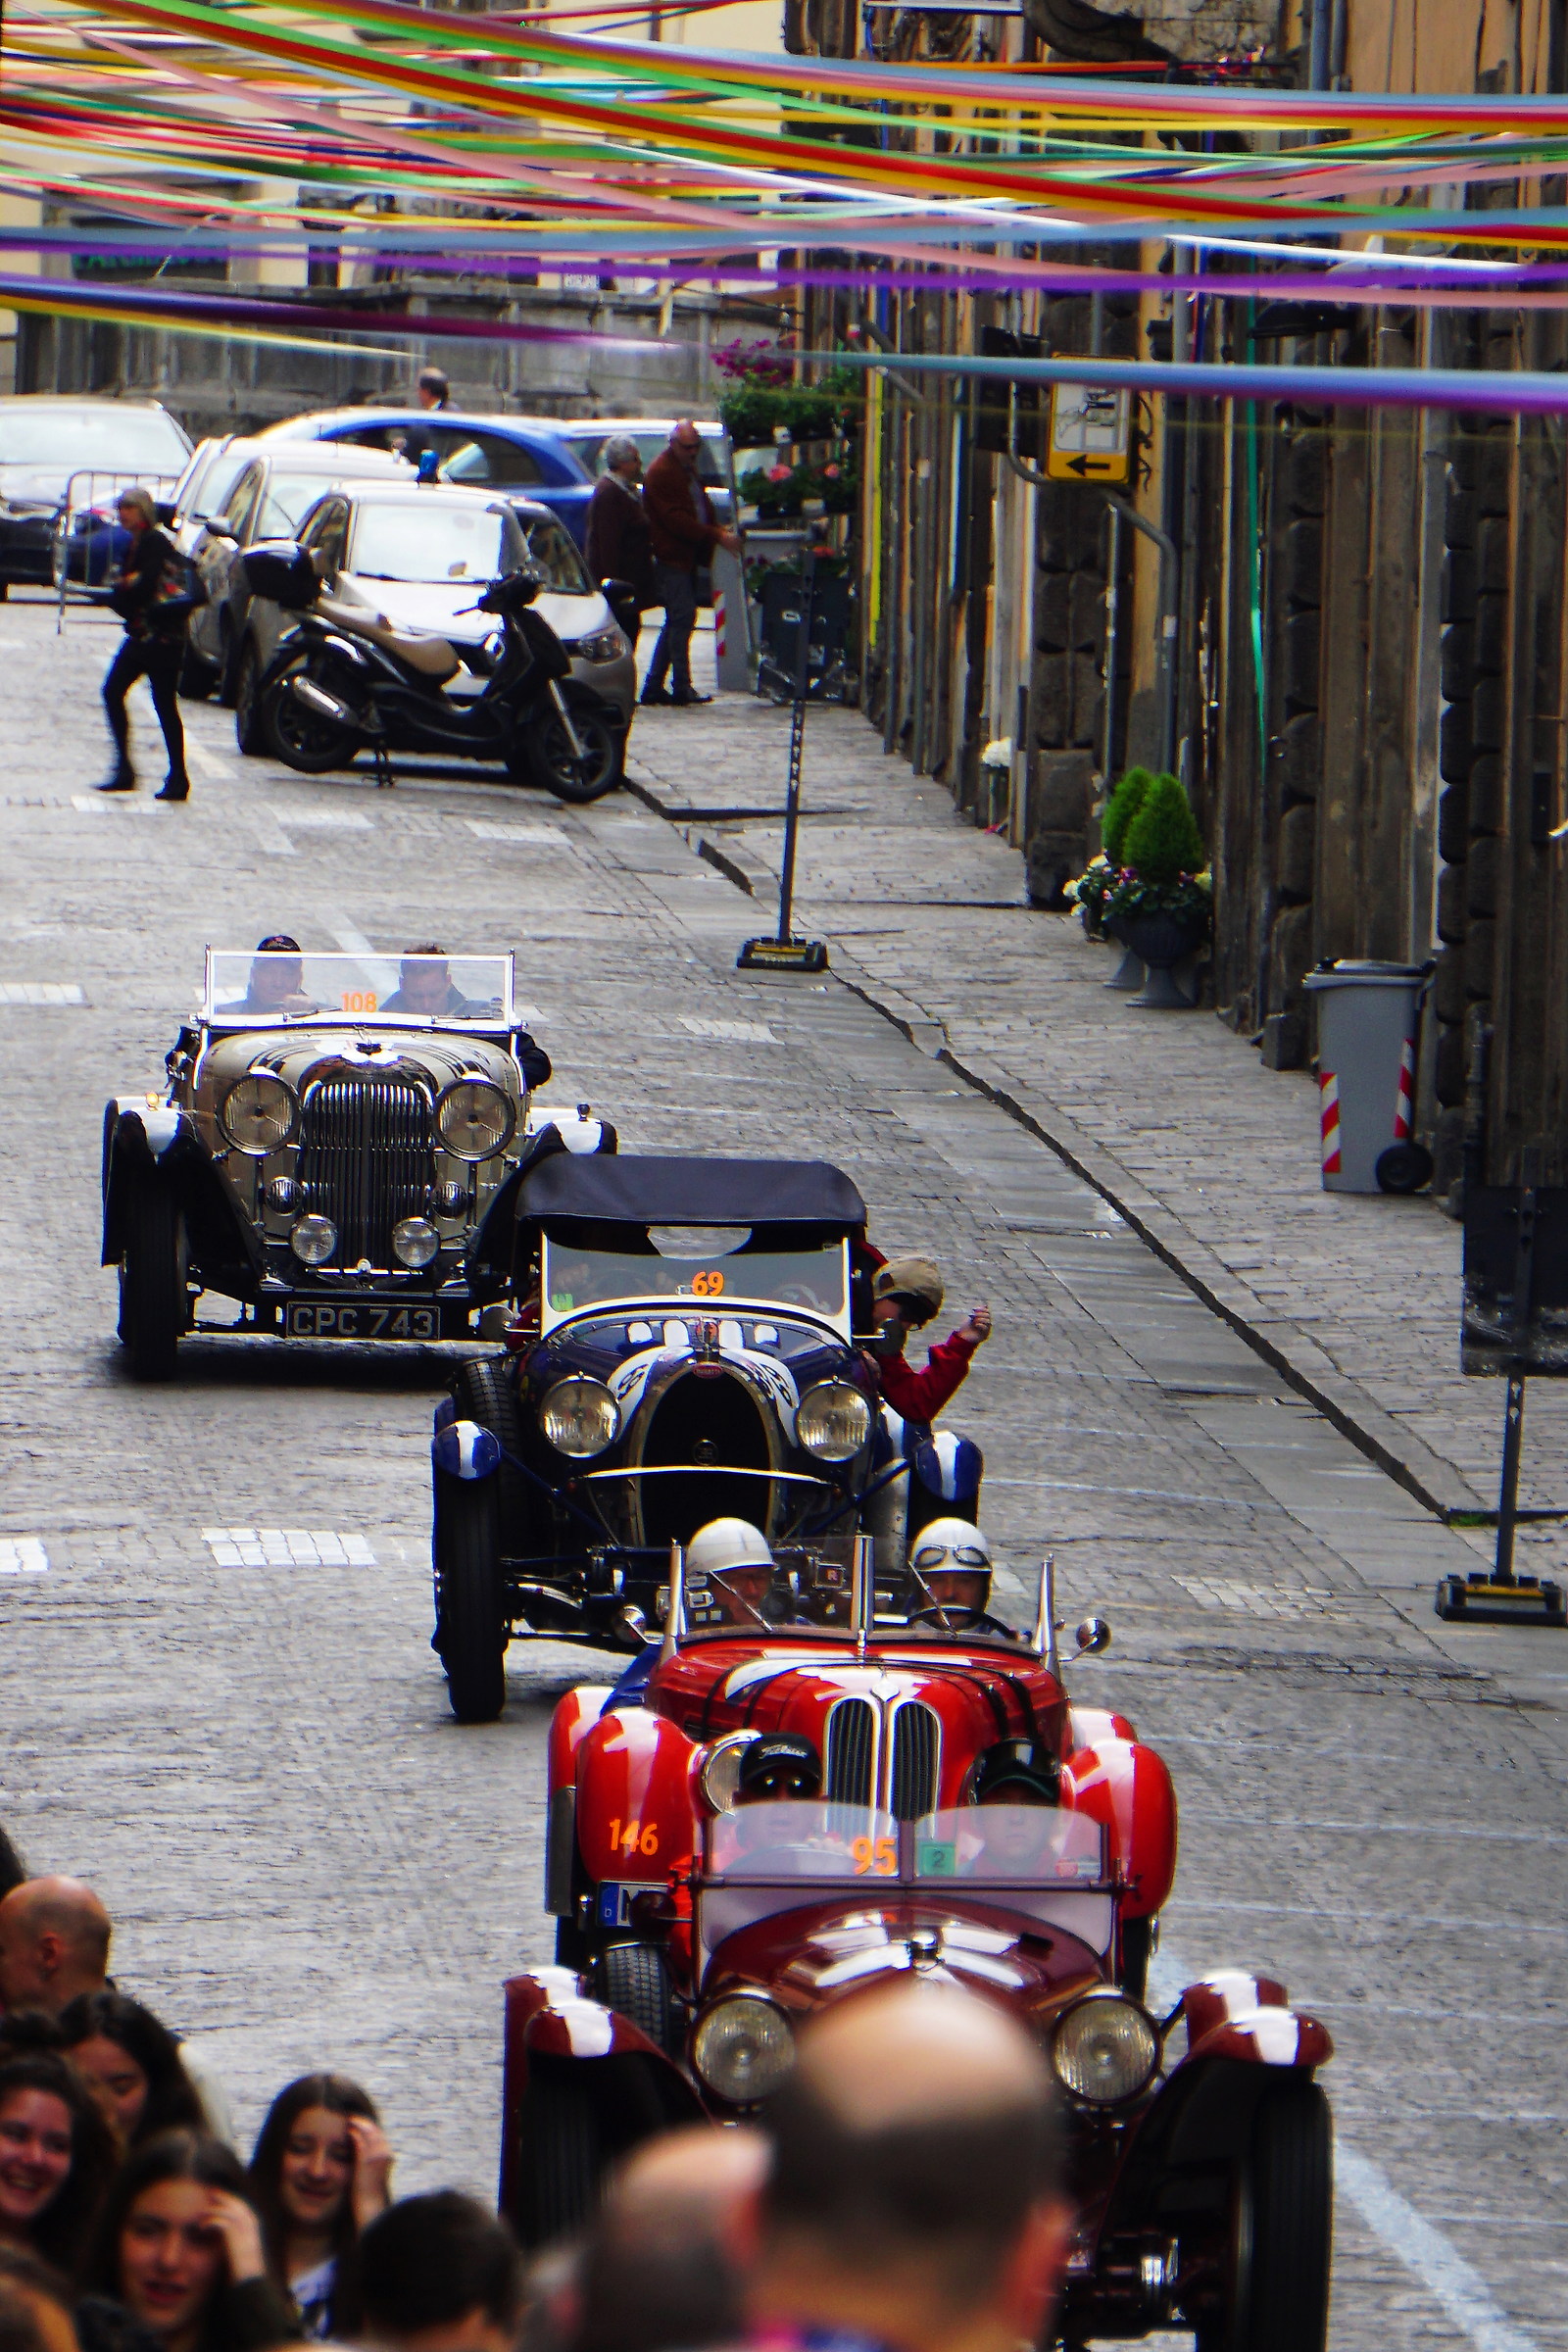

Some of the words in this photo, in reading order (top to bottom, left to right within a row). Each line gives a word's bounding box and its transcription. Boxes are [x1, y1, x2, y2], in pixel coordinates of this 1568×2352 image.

[341, 991, 377, 1012] 108
[692, 1271, 723, 1296] 69
[293, 1307, 358, 1336] CPC
[369, 1309, 433, 1338] 743
[610, 1819, 659, 1855] 146
[852, 1837, 897, 1875] 95
[932, 1849, 946, 1868] 2
